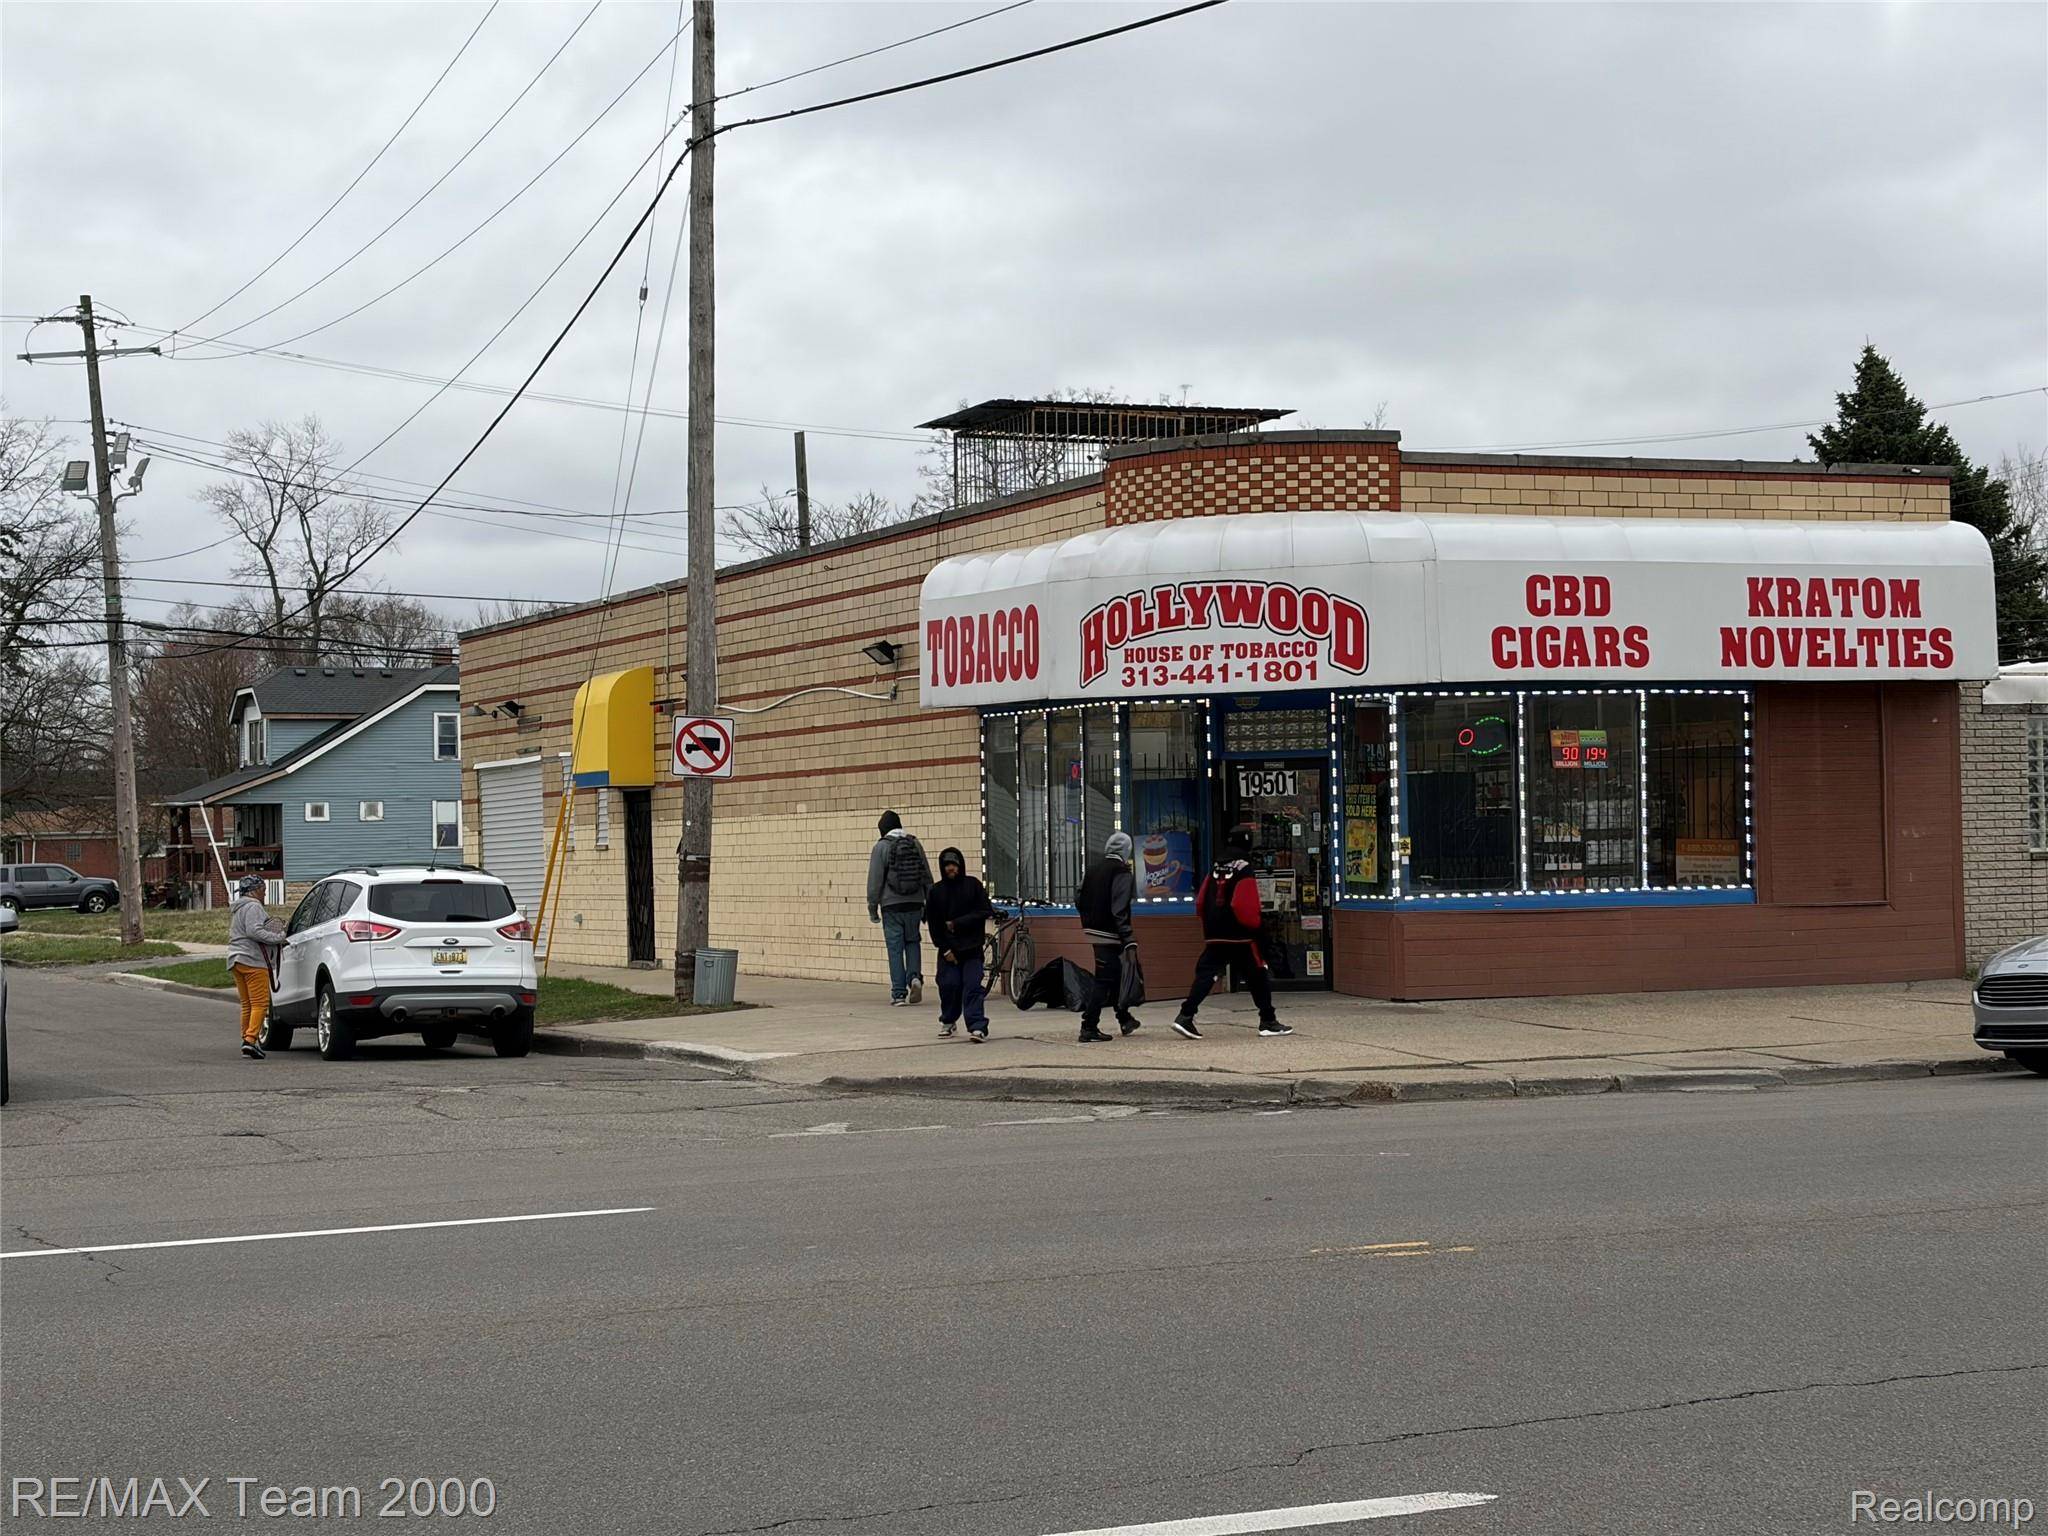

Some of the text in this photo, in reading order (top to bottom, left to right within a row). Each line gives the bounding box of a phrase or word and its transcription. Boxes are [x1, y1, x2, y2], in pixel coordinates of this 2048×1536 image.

[1526, 575, 1611, 618] CBD
[1747, 577, 1921, 619] KRATOM
[927, 604, 1039, 688] TOBACCO
[1082, 582, 1368, 685] HOLLYWOOD
[1491, 625, 1650, 670] CIGARS
[1720, 626, 1954, 670] NOVELTIES
[1124, 640, 1318, 664] HOUSE OF TOBACCO
[1121, 660, 1318, 688] 313-441-1801
[1562, 747, 1579, 761] 90
[1585, 747, 1607, 761] 194
[1240, 771, 1298, 796] 19501
[1345, 805, 1377, 817] SOLD HERE
